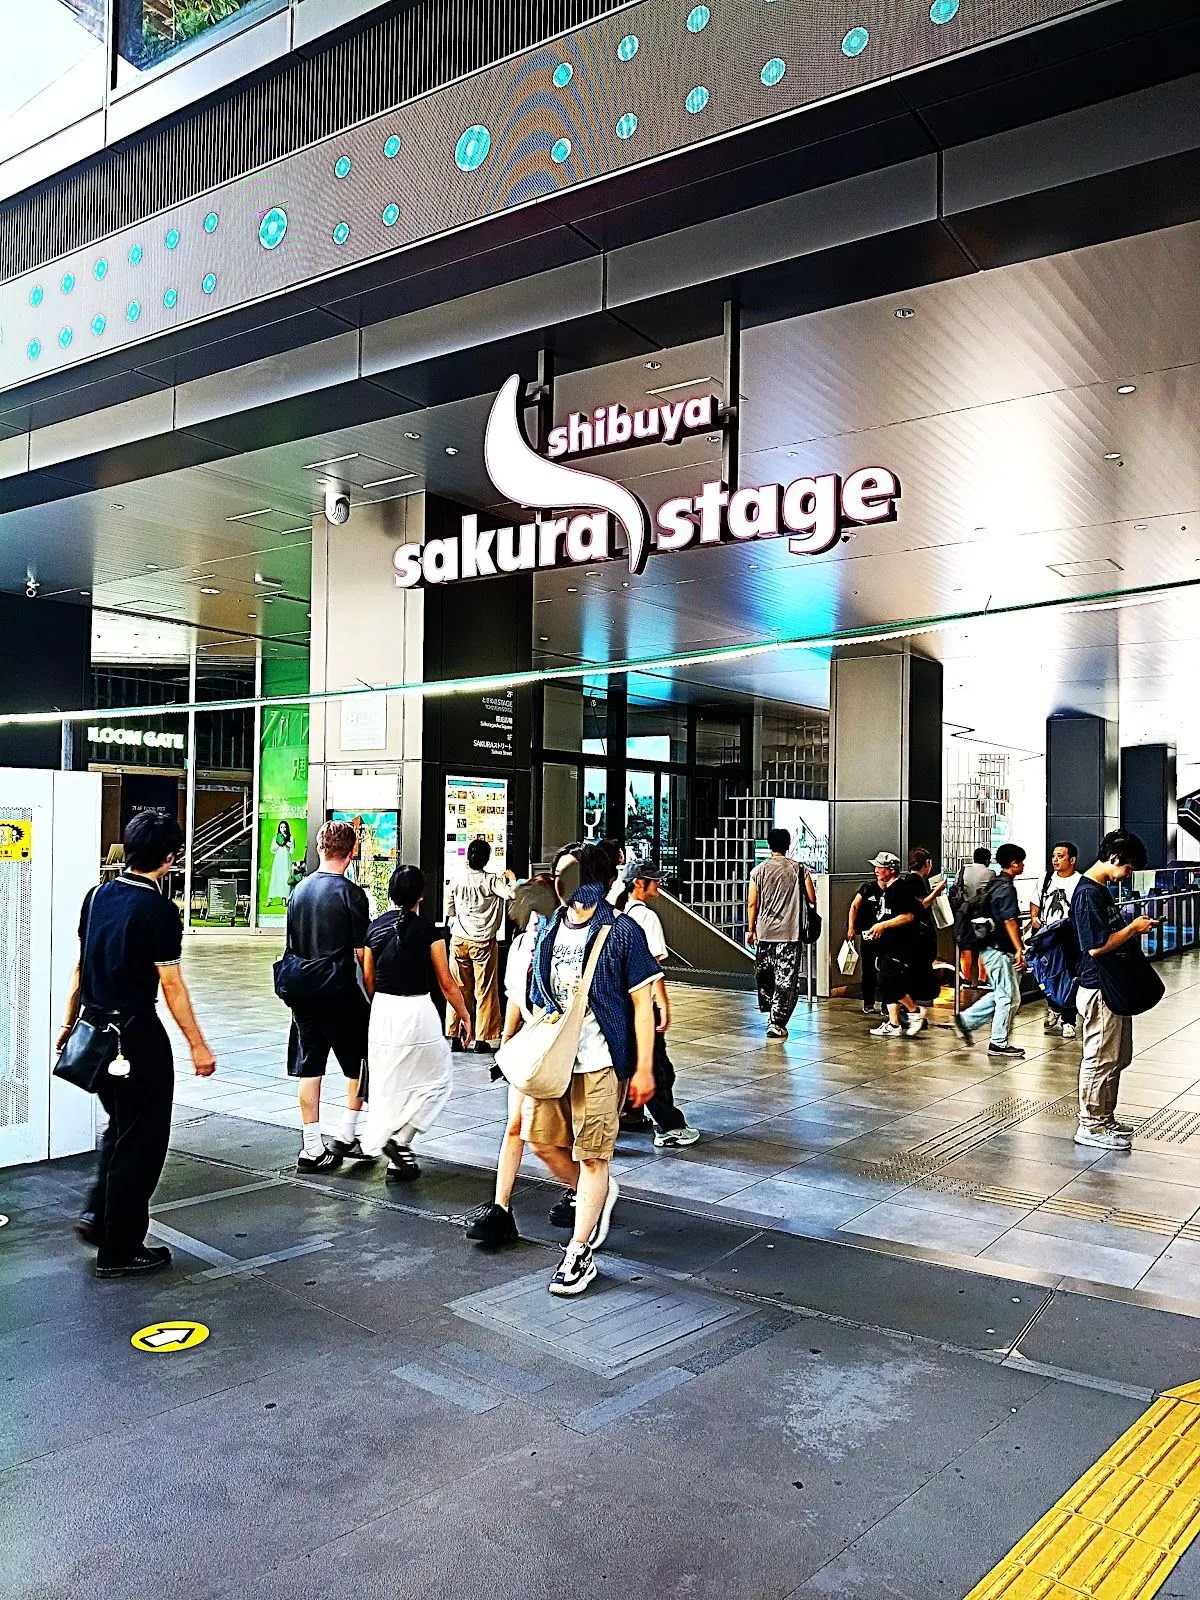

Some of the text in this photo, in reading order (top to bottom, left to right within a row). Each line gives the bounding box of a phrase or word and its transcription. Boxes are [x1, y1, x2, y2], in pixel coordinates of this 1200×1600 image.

[547, 395, 713, 458] shibuya
[656, 465, 898, 555] stage
[392, 510, 609, 589] sakura
[87, 726, 184, 749] LOOM GATE
[473, 739, 513, 750] SAKURAストリート
